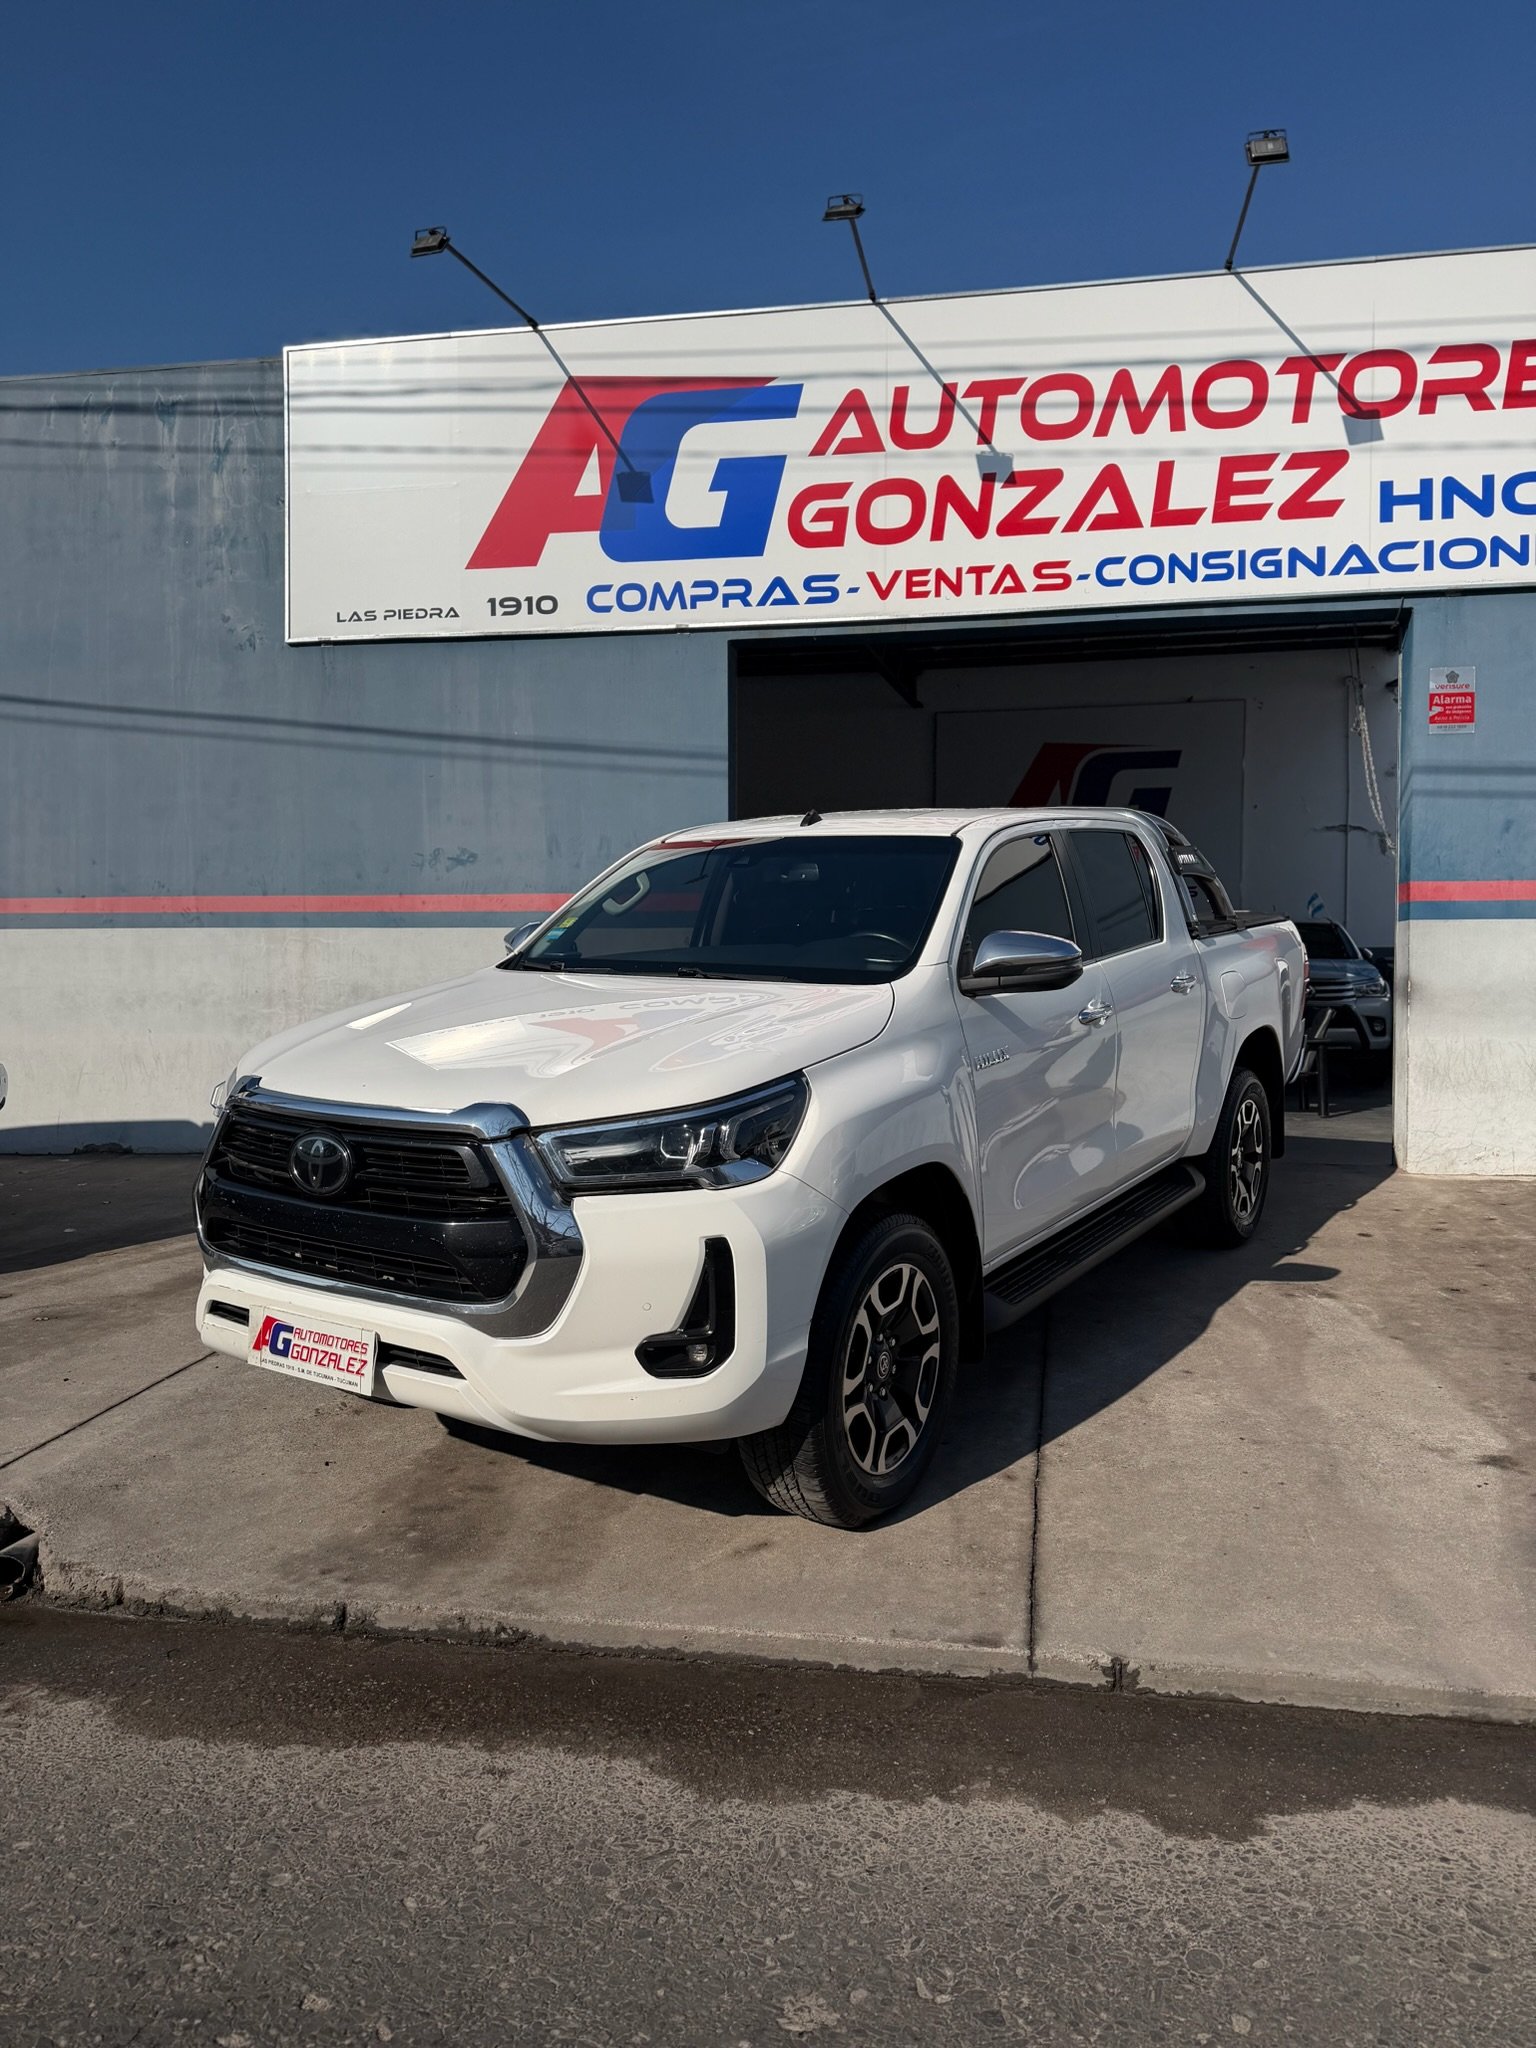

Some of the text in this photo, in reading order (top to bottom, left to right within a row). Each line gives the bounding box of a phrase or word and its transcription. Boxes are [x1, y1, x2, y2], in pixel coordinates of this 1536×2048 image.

[465, 375, 804, 570] AG
[787, 449, 1350, 549] GONZALEZ
[336, 607, 460, 623] LAS PIEDRA
[486, 595, 559, 617] 1910
[1433, 695, 1472, 704] Alarma
[252, 1315, 294, 1358] AG
[293, 1327, 369, 1355] AUTOMOTORES
[290, 1343, 368, 1377] GONZALEZ
